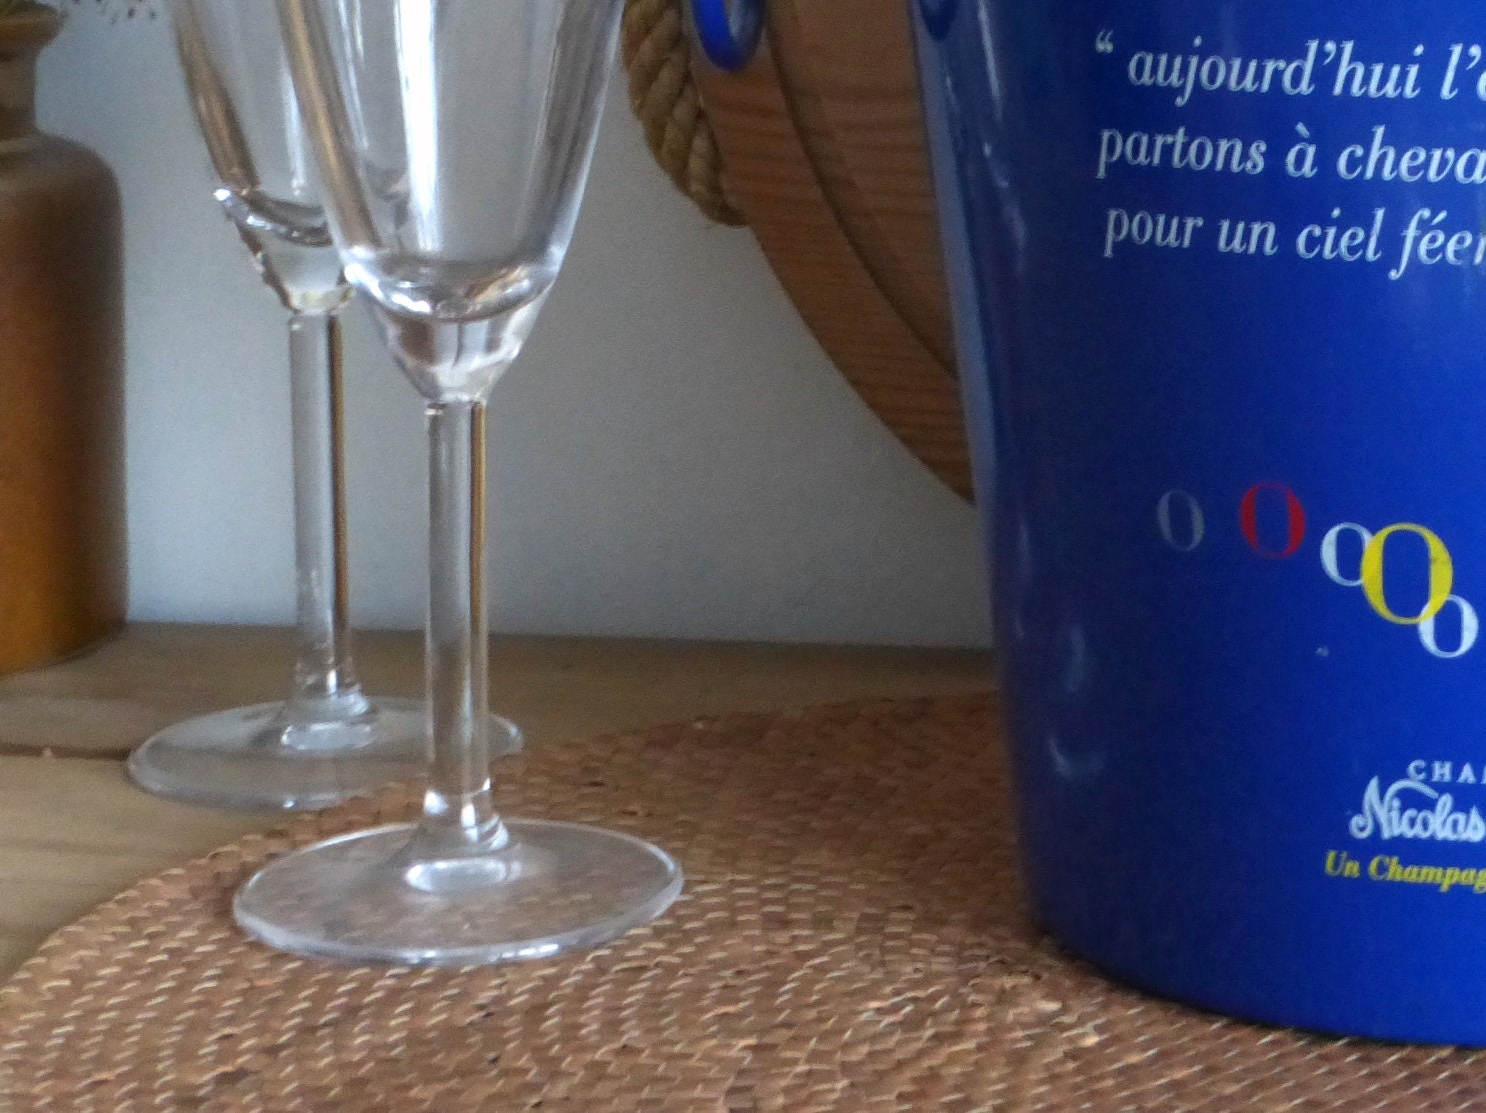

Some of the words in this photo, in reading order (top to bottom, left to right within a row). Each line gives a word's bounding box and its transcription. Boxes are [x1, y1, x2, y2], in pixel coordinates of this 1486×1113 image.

[1096, 126, 1267, 179] partons
[1285, 122, 1318, 178] à
[1103, 208, 1204, 258] pour
[1217, 218, 1278, 256] un
[1295, 207, 1386, 262] ciel
[1349, 774, 1486, 842] Nicolas
[1324, 850, 1361, 878] Un
